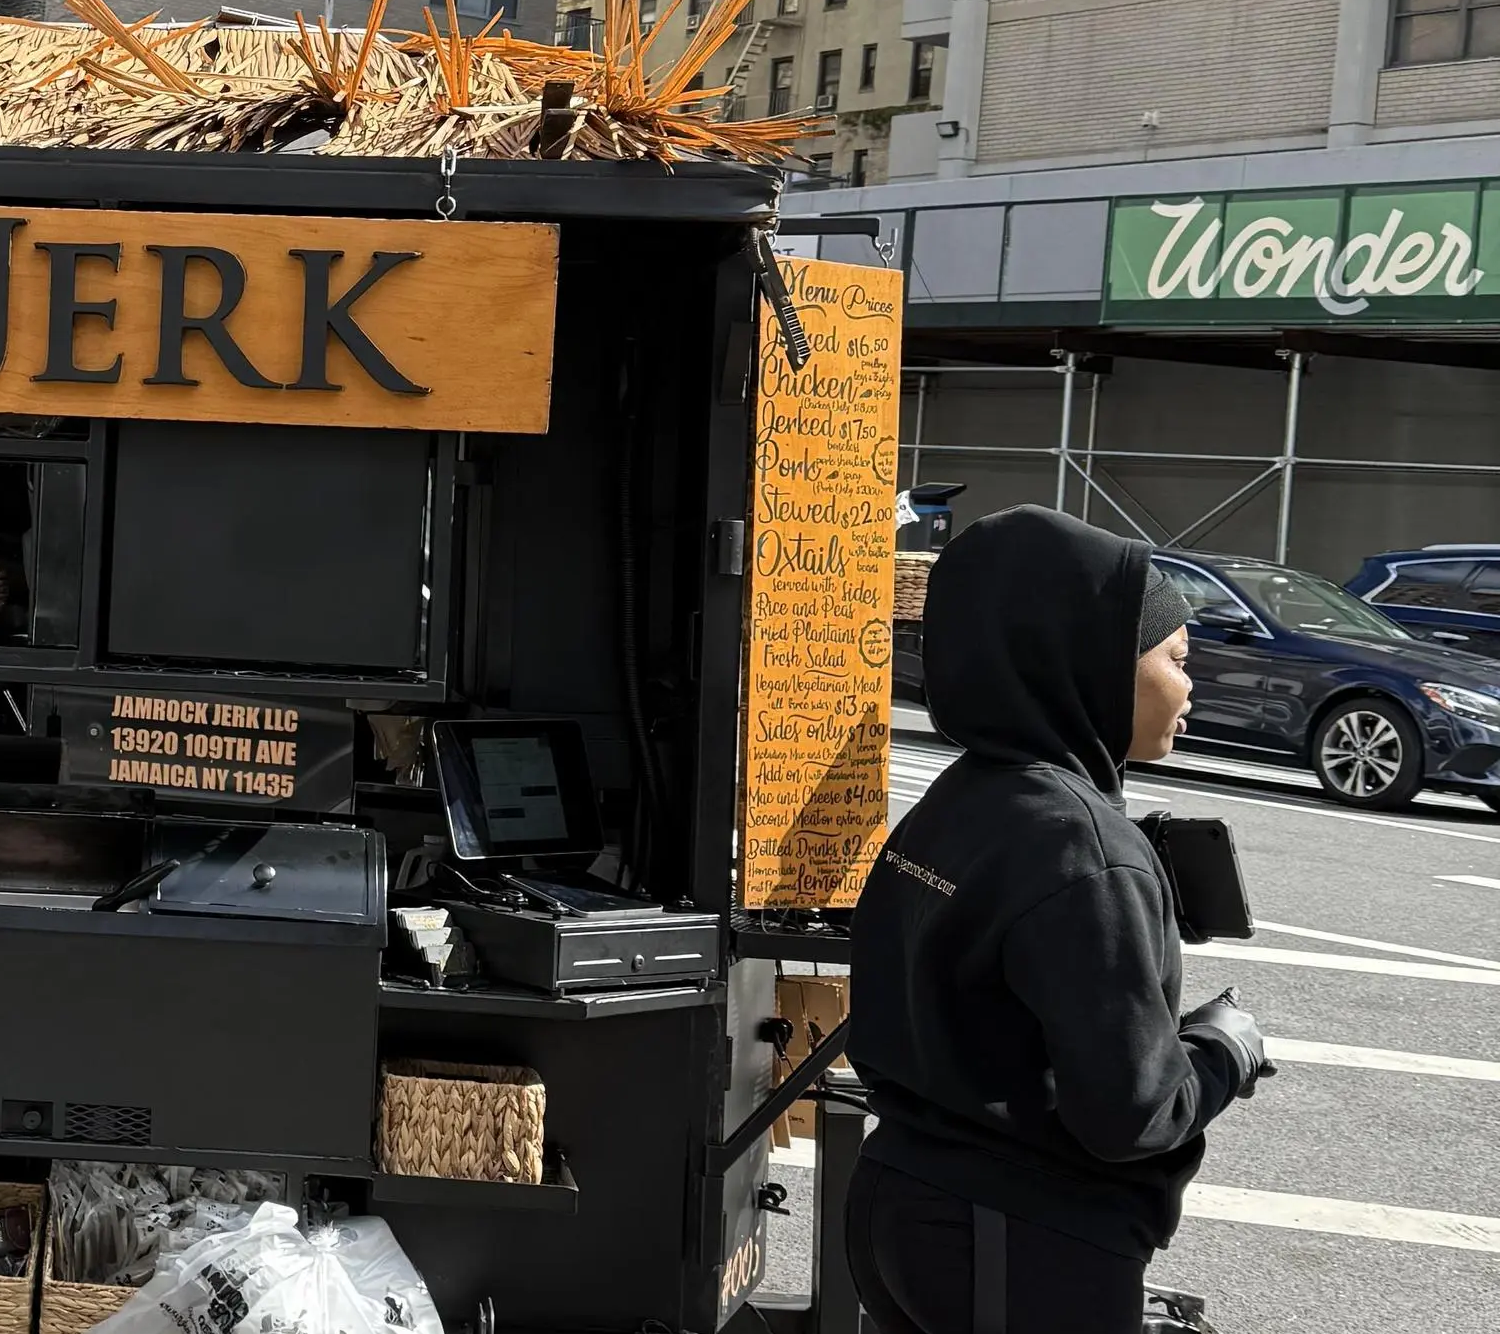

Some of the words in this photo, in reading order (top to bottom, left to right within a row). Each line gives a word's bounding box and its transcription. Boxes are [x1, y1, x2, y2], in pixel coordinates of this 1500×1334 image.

[1147, 196, 1485, 315] Wonder
[777, 260, 839, 304] Menu
[842, 284, 895, 323] Prices
[847, 335, 889, 358] $16.50
[761, 353, 857, 403] Chicken
[757, 400, 836, 444] Jerked
[839, 419, 876, 441] $17.50
[755, 440, 821, 482] Pork
[758, 483, 841, 525] Stewed
[841, 501, 893, 529] $22.00
[757, 529, 850, 578] Oxtails
[756, 591, 788, 620] Rice
[792, 598, 819, 617] and
[821, 594, 855, 619] Peas
[772, 577, 809, 592] served
[811, 576, 837, 592] with
[841, 580, 880, 608] sides
[753, 619, 789, 642] Fried
[792, 619, 855, 644] Plantains
[764, 644, 803, 668] Fresh
[805, 644, 847, 668] Salad
[853, 675, 883, 695] Meal
[111, 695, 209, 724] JAMROCK
[211, 703, 260, 729] JERK
[264, 708, 298, 733] LLC
[834, 694, 878, 717] $13.00
[110, 727, 179, 755] 13920
[184, 733, 251, 762] 109TH
[255, 740, 297, 766] AVE
[756, 710, 802, 743] Sides
[806, 714, 848, 749] only
[109, 759, 198, 789] JAMAICA
[202, 767, 230, 791] NY
[233, 770, 294, 798] 11435
[756, 762, 782, 785] Add
[786, 766, 802, 782] on
[748, 786, 775, 806] Mac
[777, 788, 799, 805] and
[802, 785, 841, 807] Cheese
[844, 784, 884, 807] $4.00
[748, 806, 790, 828] Second
[836, 809, 865, 827] extra
[747, 839, 793, 860] Bottled
[795, 837, 839, 859] Drinks
[842, 834, 884, 858] $2.00
